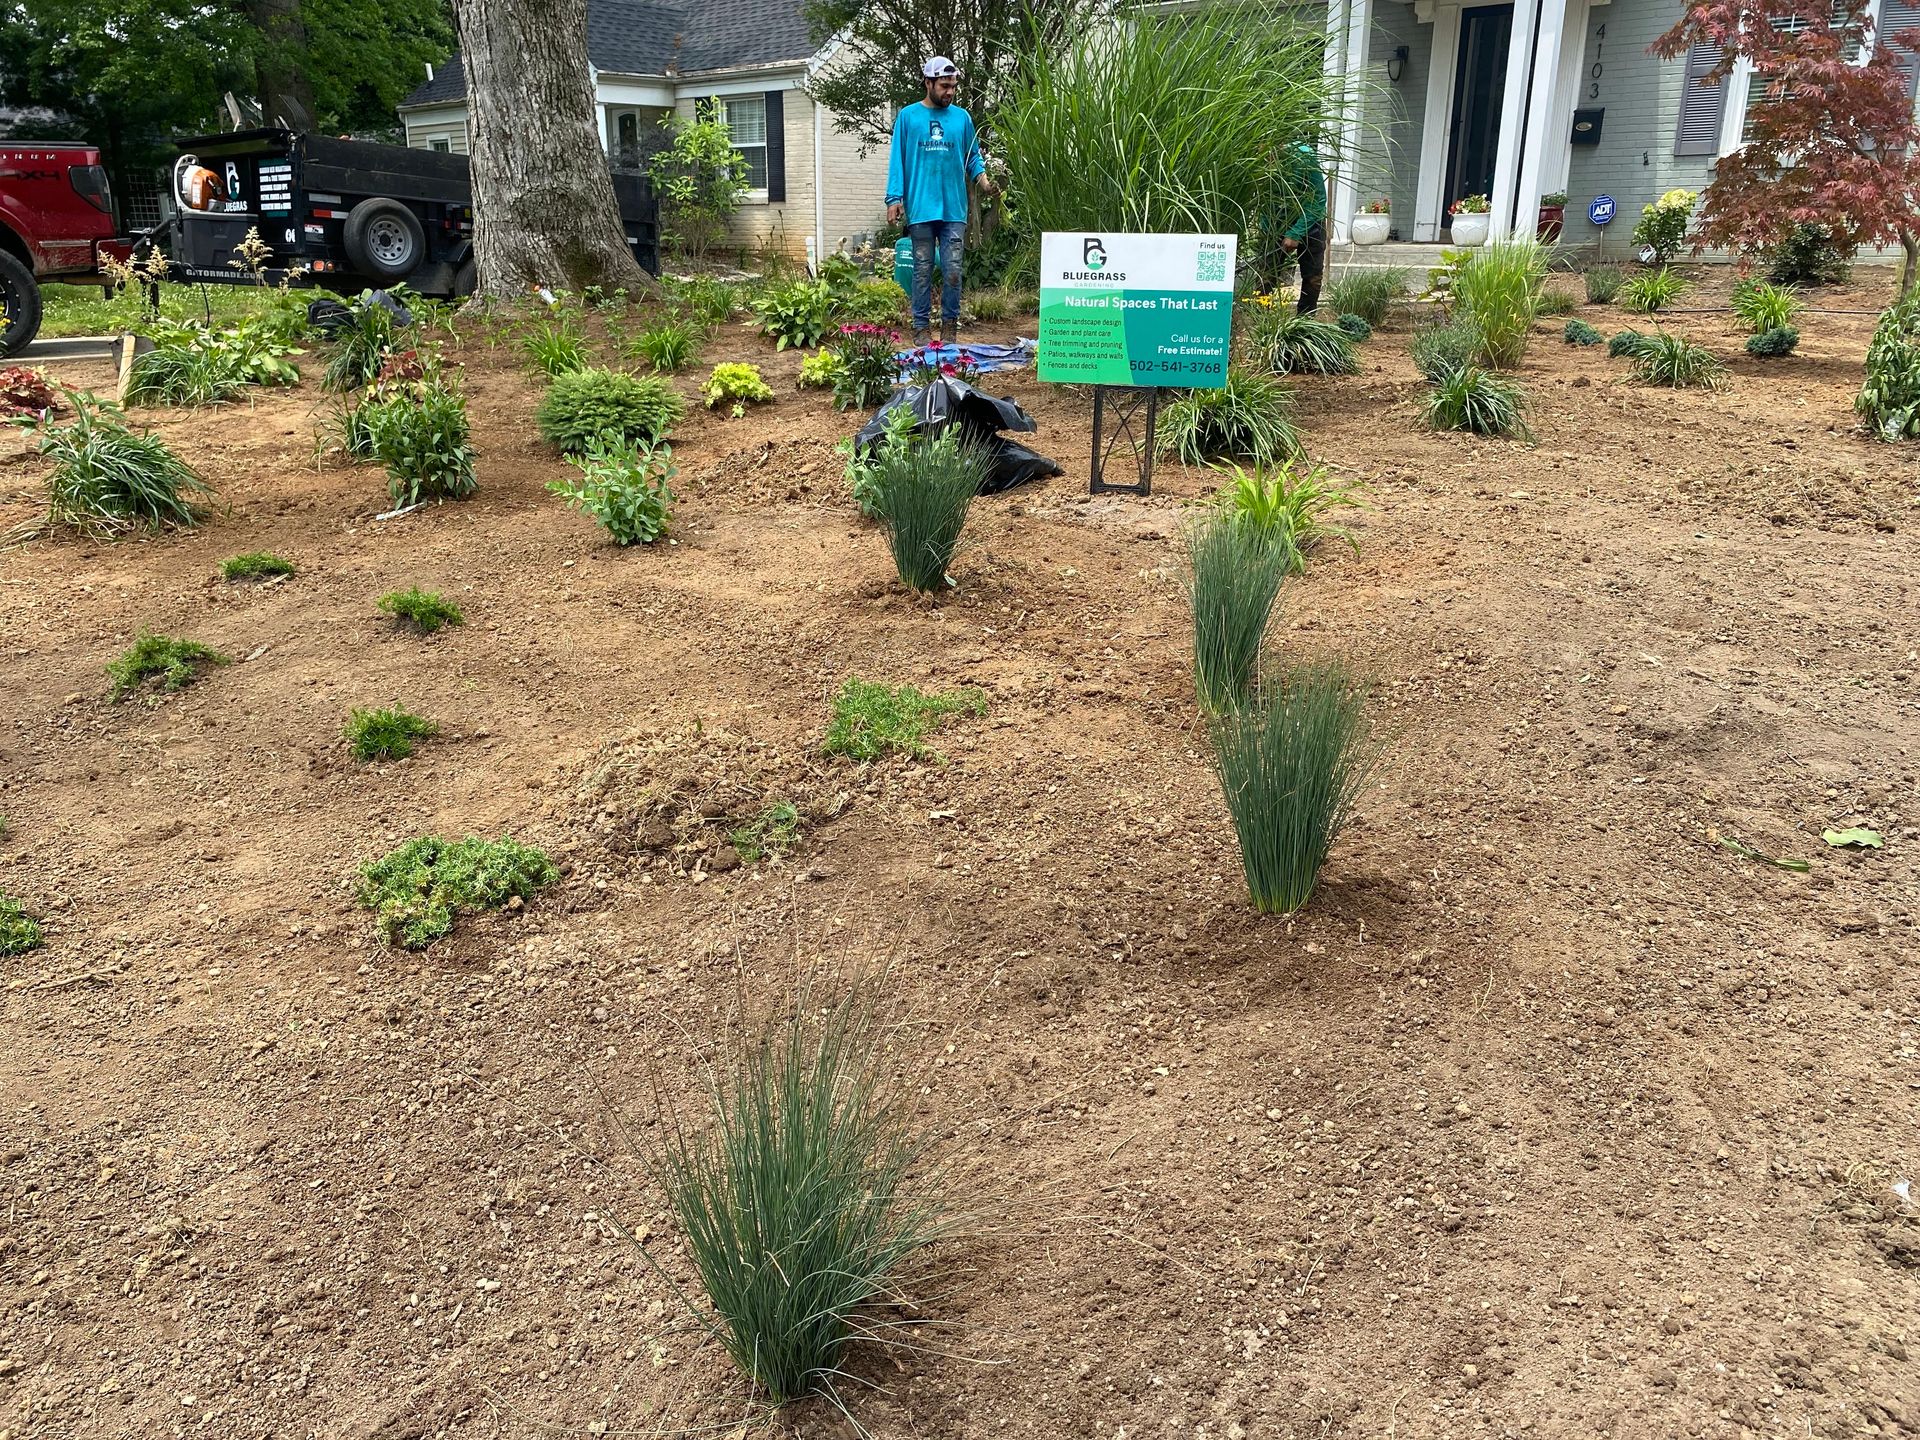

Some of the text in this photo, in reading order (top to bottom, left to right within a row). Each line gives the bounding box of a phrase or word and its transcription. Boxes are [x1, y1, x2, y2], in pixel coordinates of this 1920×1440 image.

[1589, 23, 1606, 99] 4103
[1594, 203, 1612, 216] ADT
[1200, 242, 1215, 250] Find
[1063, 272, 1126, 281] BLUEGRASS
[1065, 296, 1218, 311] Natural Spaces That Last
[1072, 318, 1101, 326] landscape
[1102, 319, 1122, 327] design
[1170, 334, 1188, 343] Call
[1203, 335, 1216, 344] for
[1158, 346, 1222, 356] Free Estimate!
[1130, 360, 1221, 373] 502-541-3768
